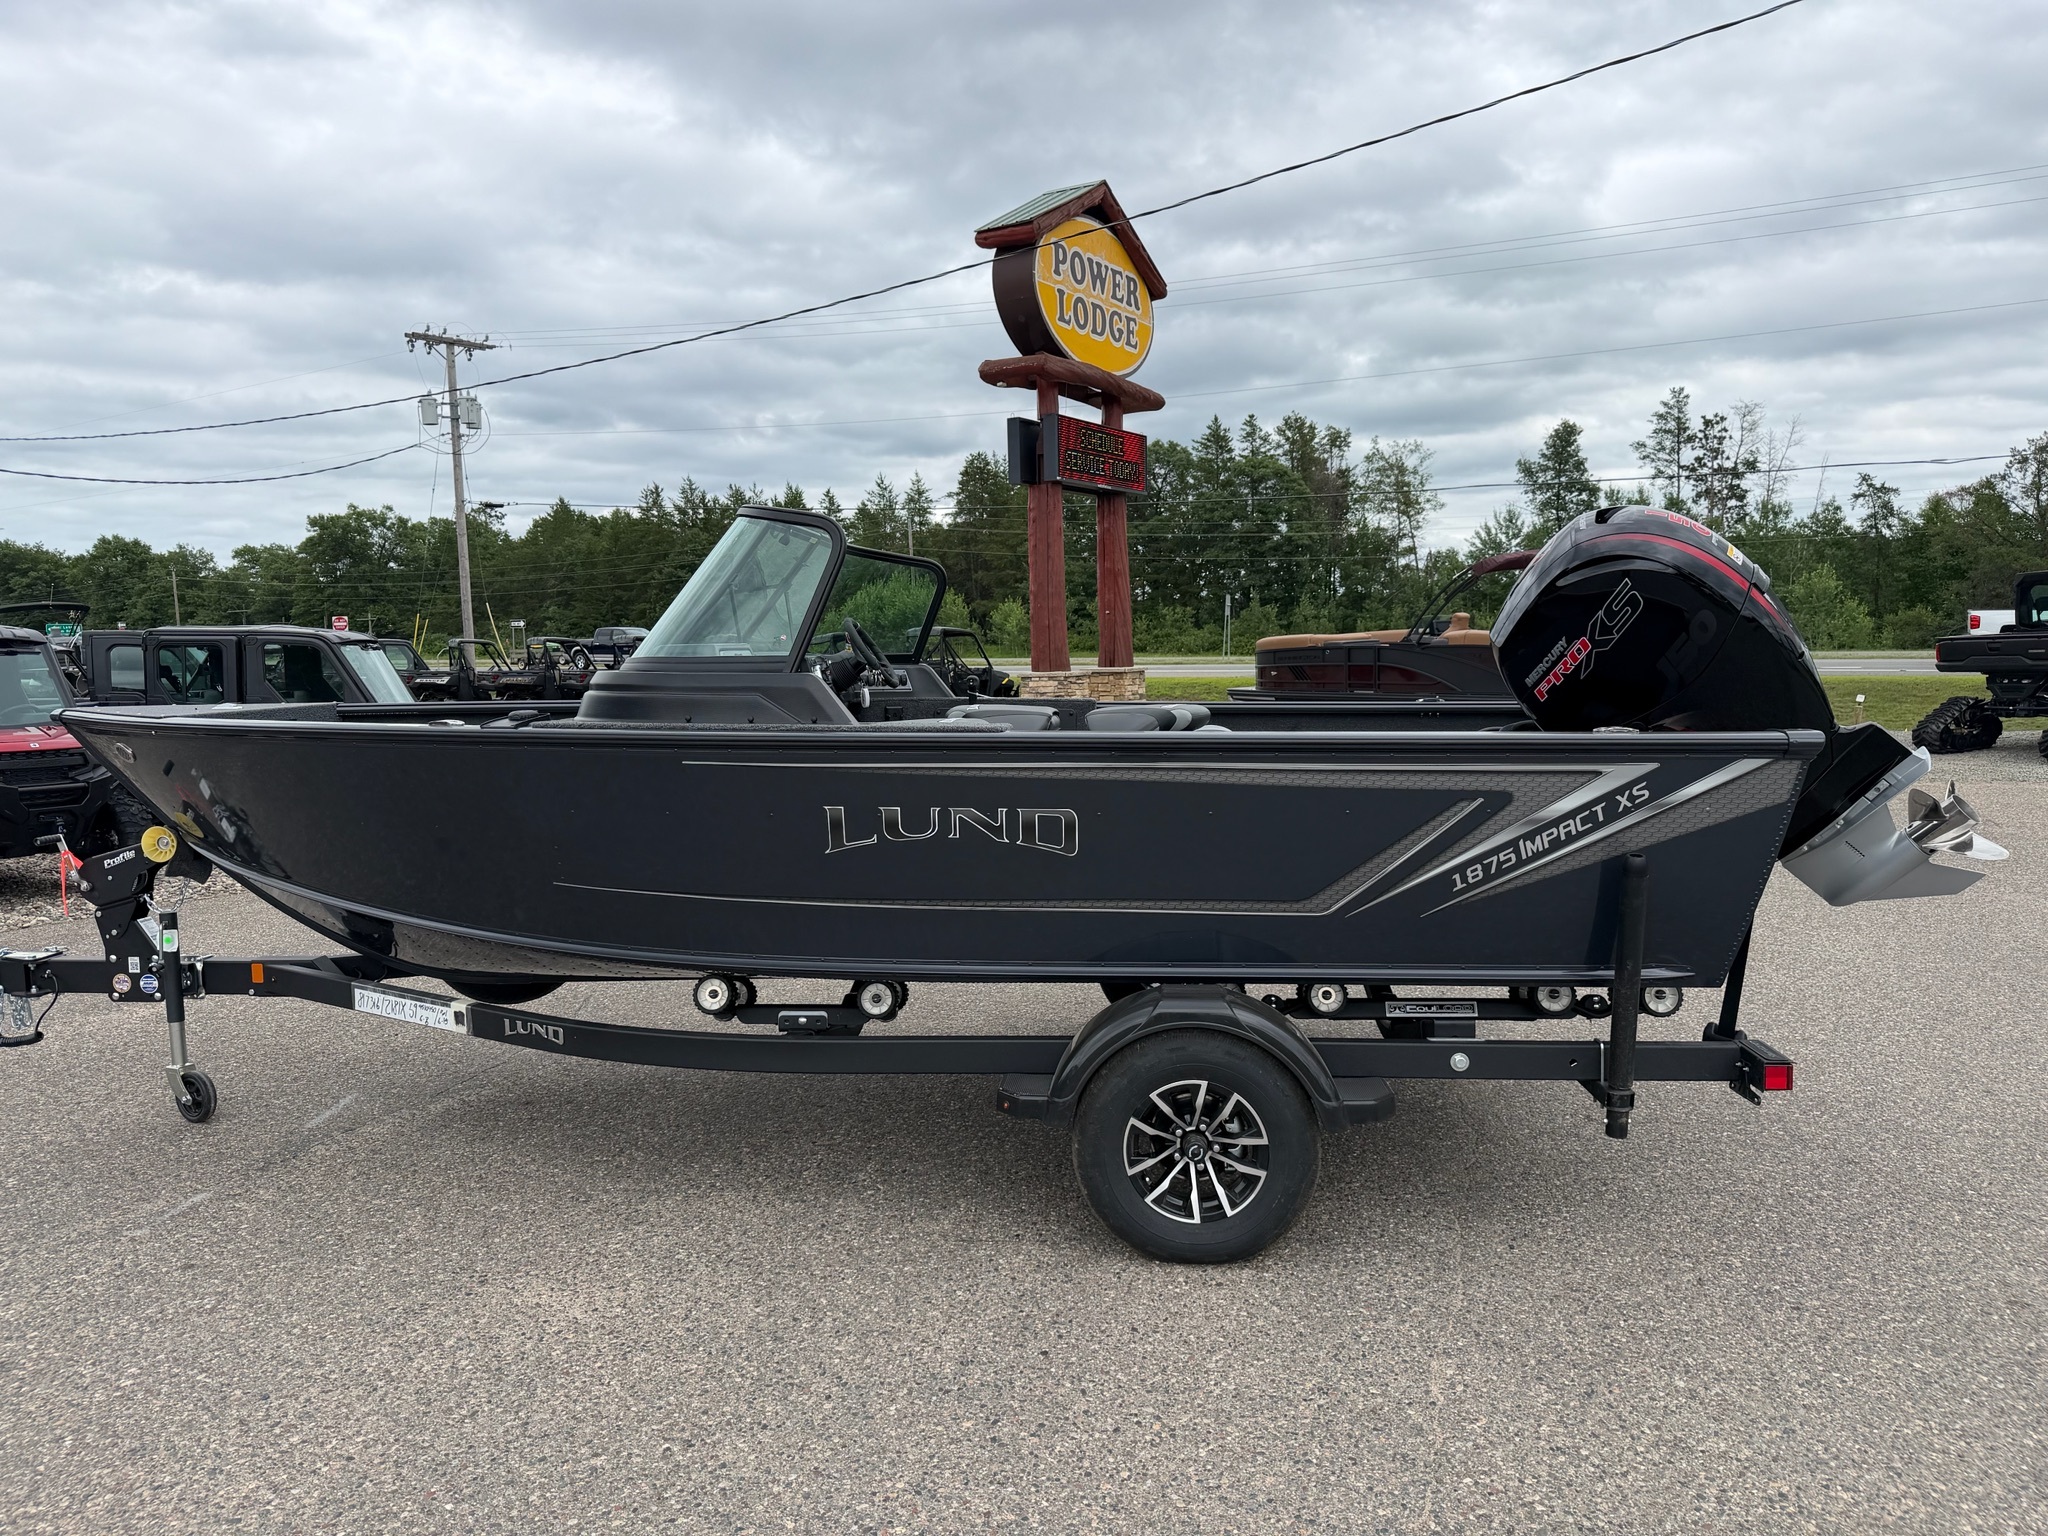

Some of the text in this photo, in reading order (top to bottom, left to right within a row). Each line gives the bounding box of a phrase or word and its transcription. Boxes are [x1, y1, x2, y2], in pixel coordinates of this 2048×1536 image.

[1051, 240, 1141, 312] POWER
[1055, 287, 1139, 351] LODGE
[1524, 636, 1568, 687] MERCURY
[1534, 577, 1644, 702] PRO XS
[823, 805, 1080, 857] LUND
[1451, 781, 1650, 892] 1875 IMPACT XS
[503, 1018, 565, 1046] LUND
